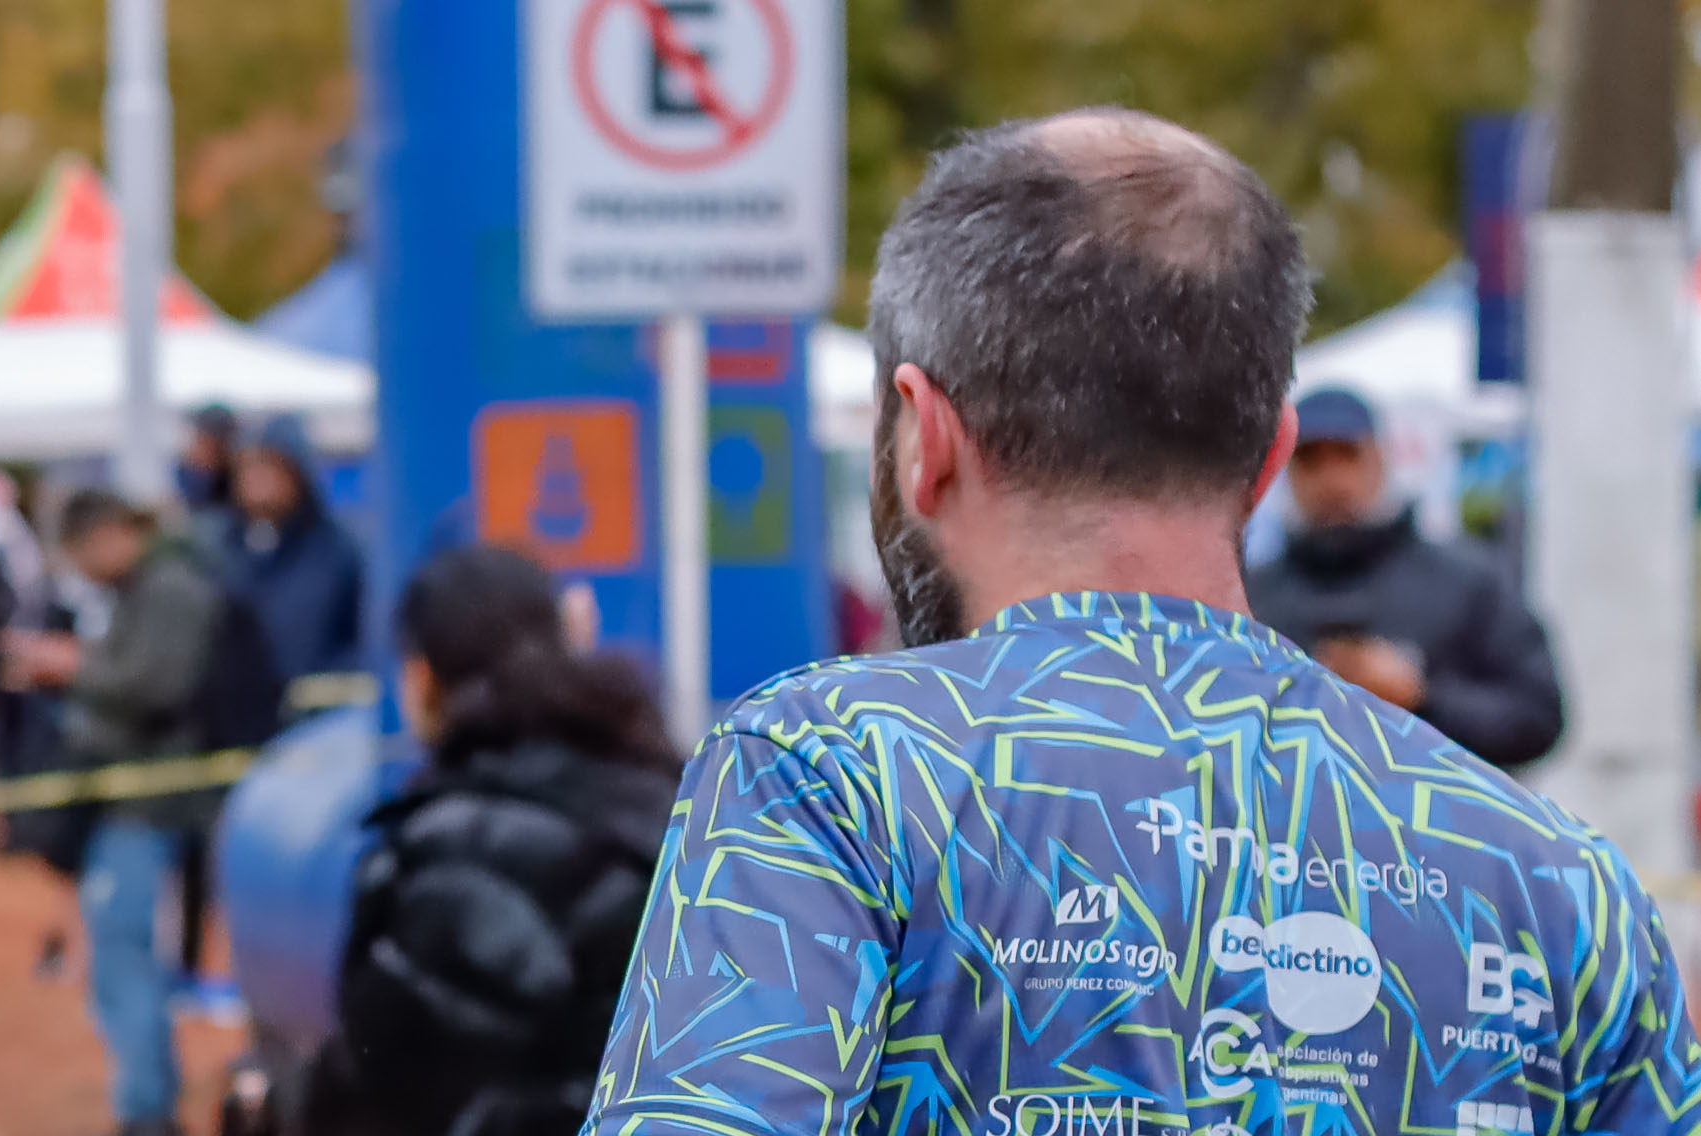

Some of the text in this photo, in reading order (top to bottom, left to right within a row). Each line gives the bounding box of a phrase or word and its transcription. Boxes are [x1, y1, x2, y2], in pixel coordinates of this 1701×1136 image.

[1304, 856, 1448, 906] energía
[1024, 977, 1064, 990] GRUPO
[1066, 978, 1104, 991] PEREZ
[1357, 1050, 1379, 1068] de
